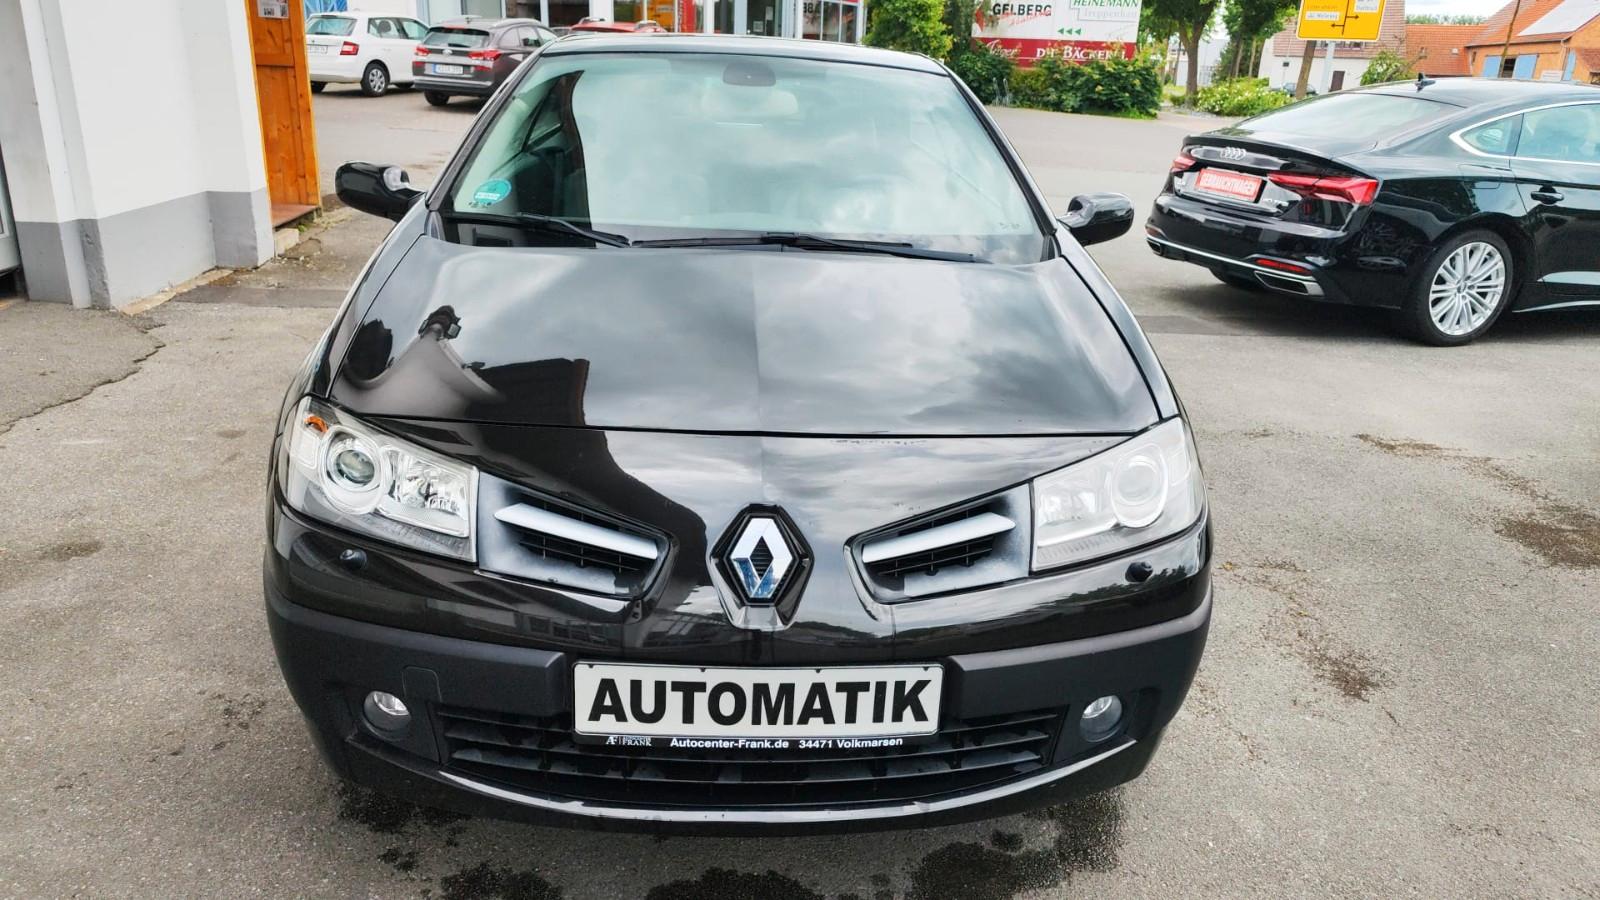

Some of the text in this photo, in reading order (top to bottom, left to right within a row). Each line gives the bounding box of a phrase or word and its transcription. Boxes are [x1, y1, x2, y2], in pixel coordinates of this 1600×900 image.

[992, 3, 1052, 16] GELBERG
[588, 678, 932, 725] AUTOMATIK
[670, 737, 903, 749] Autocenter-Frank.de 34471 Volkmarsen
